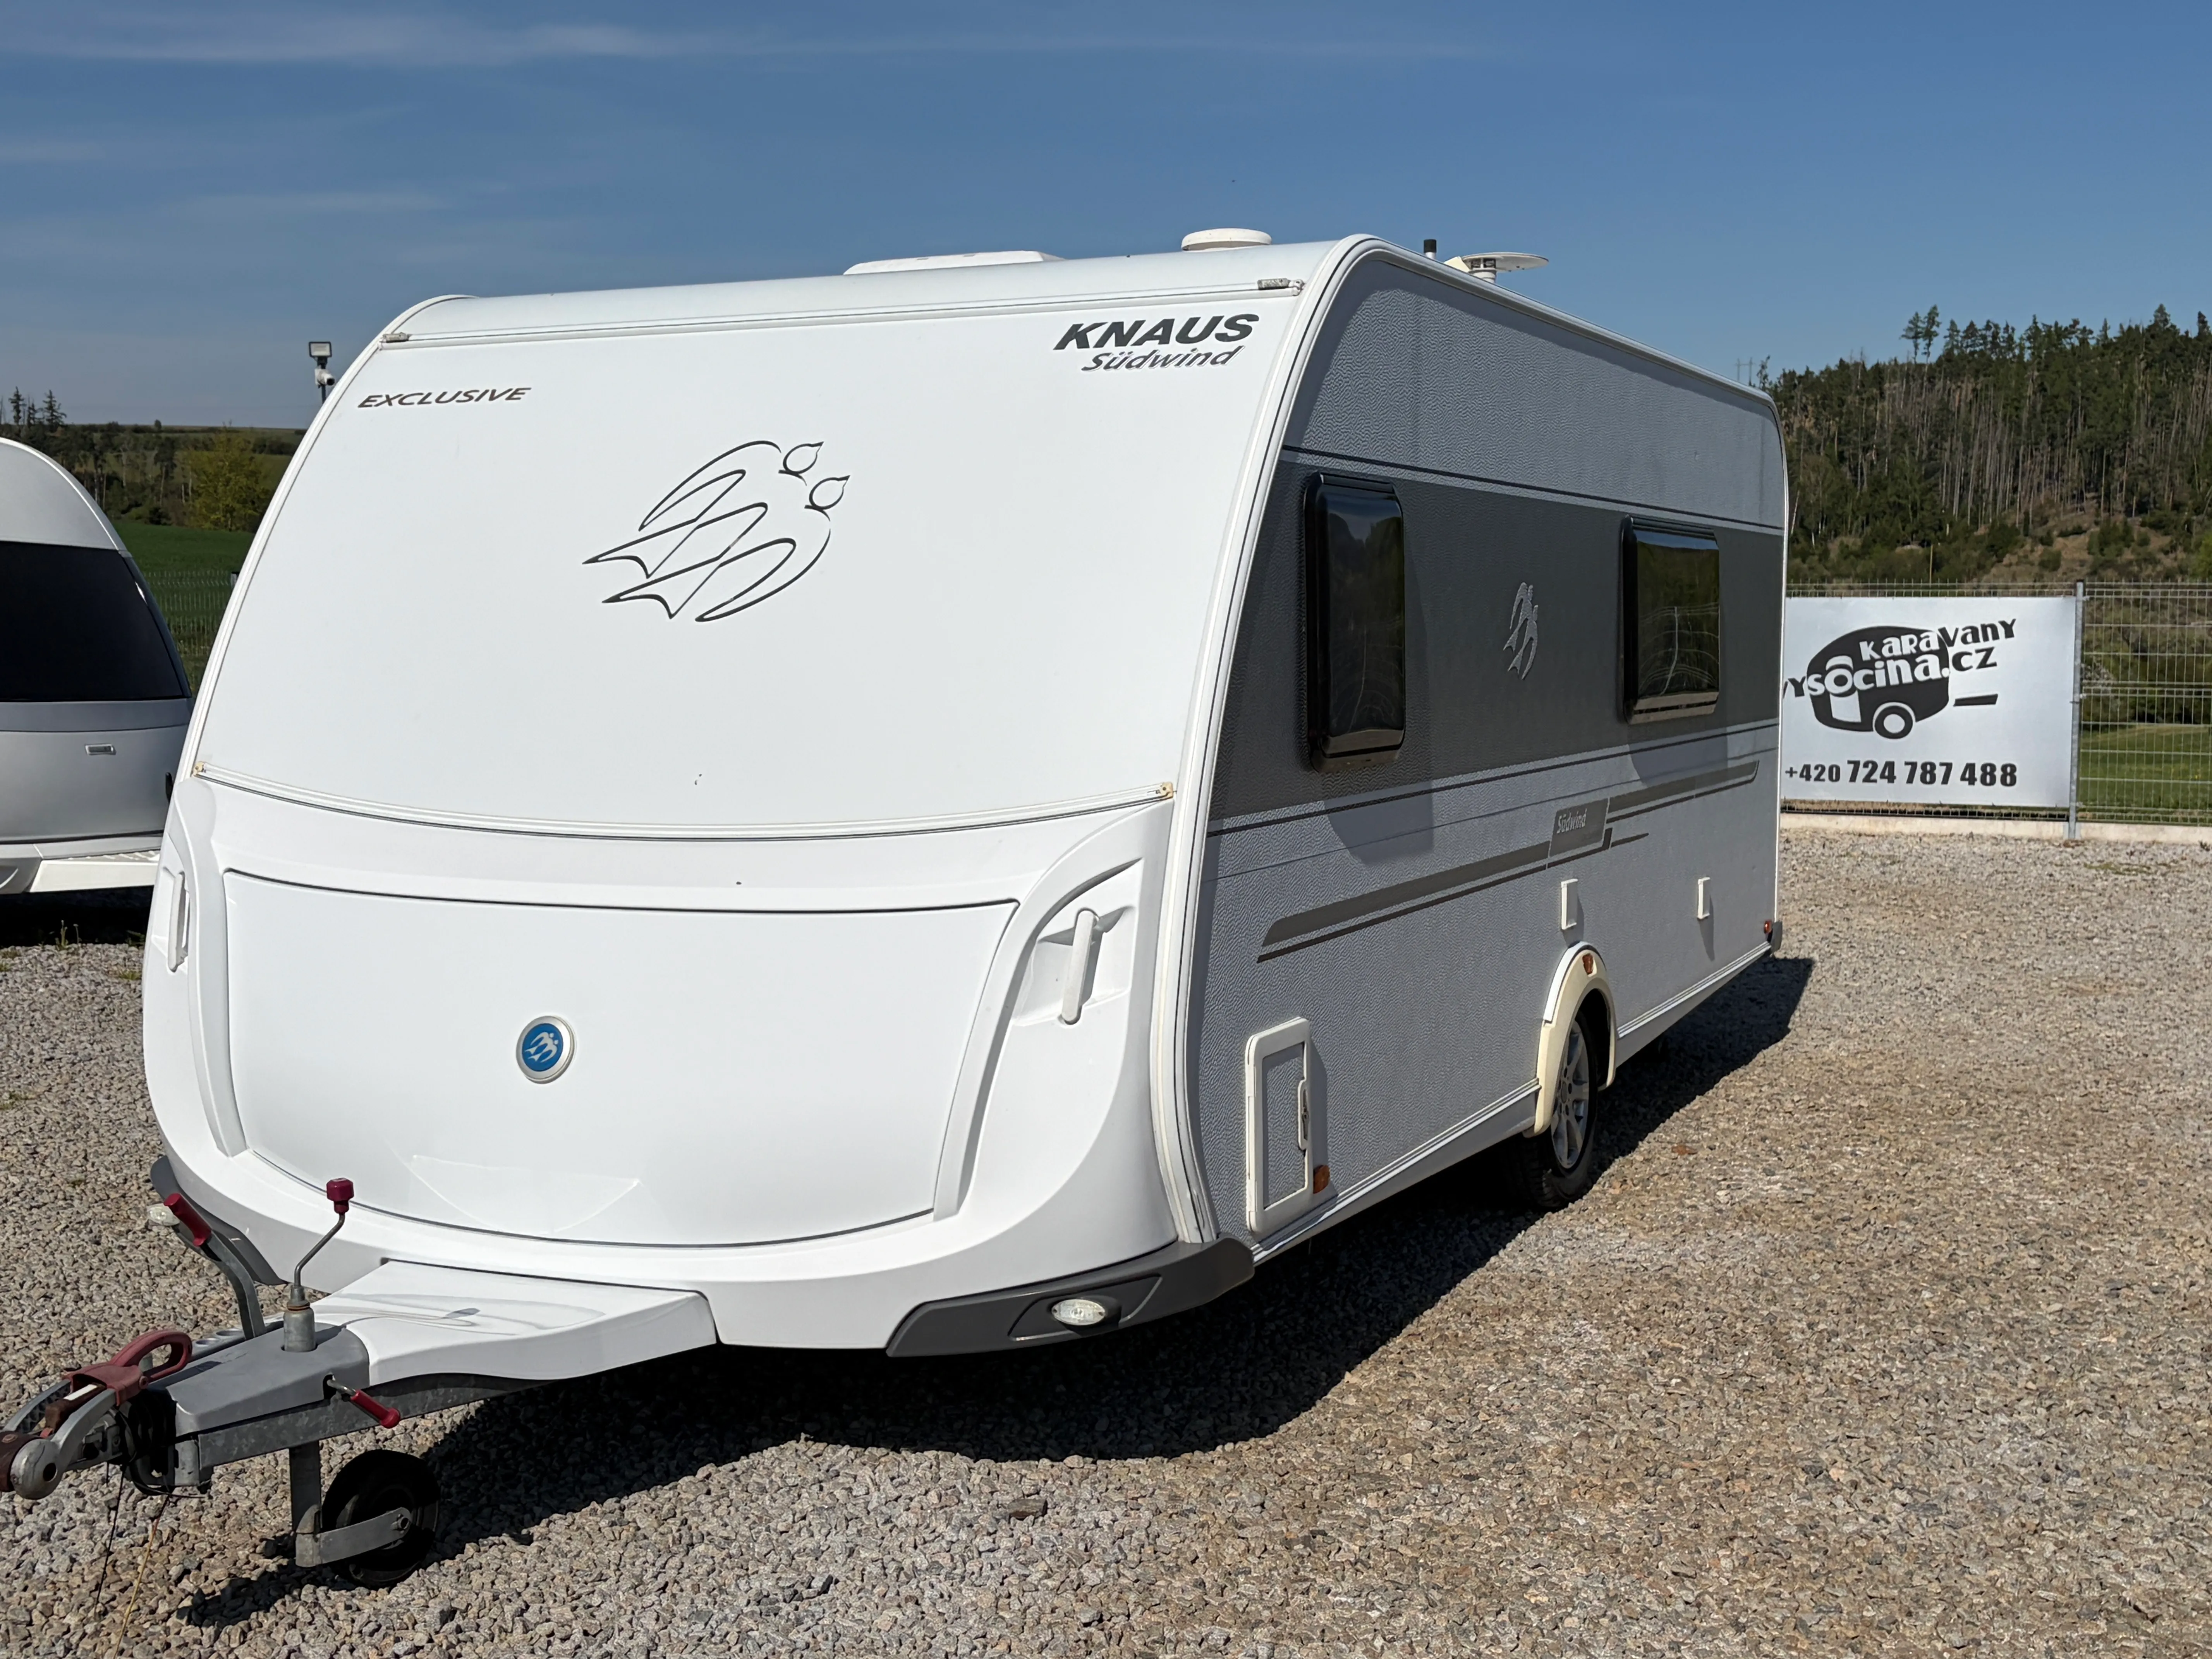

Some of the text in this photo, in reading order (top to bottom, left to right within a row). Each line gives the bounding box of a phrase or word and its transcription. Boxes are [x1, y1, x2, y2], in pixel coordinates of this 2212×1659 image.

[1053, 314, 1259, 350] KNAUS
[1081, 345, 1245, 371] Südwind
[357, 387, 531, 408] EXCLUSIVE
[1785, 759, 2017, 787] +420 724 787 488
